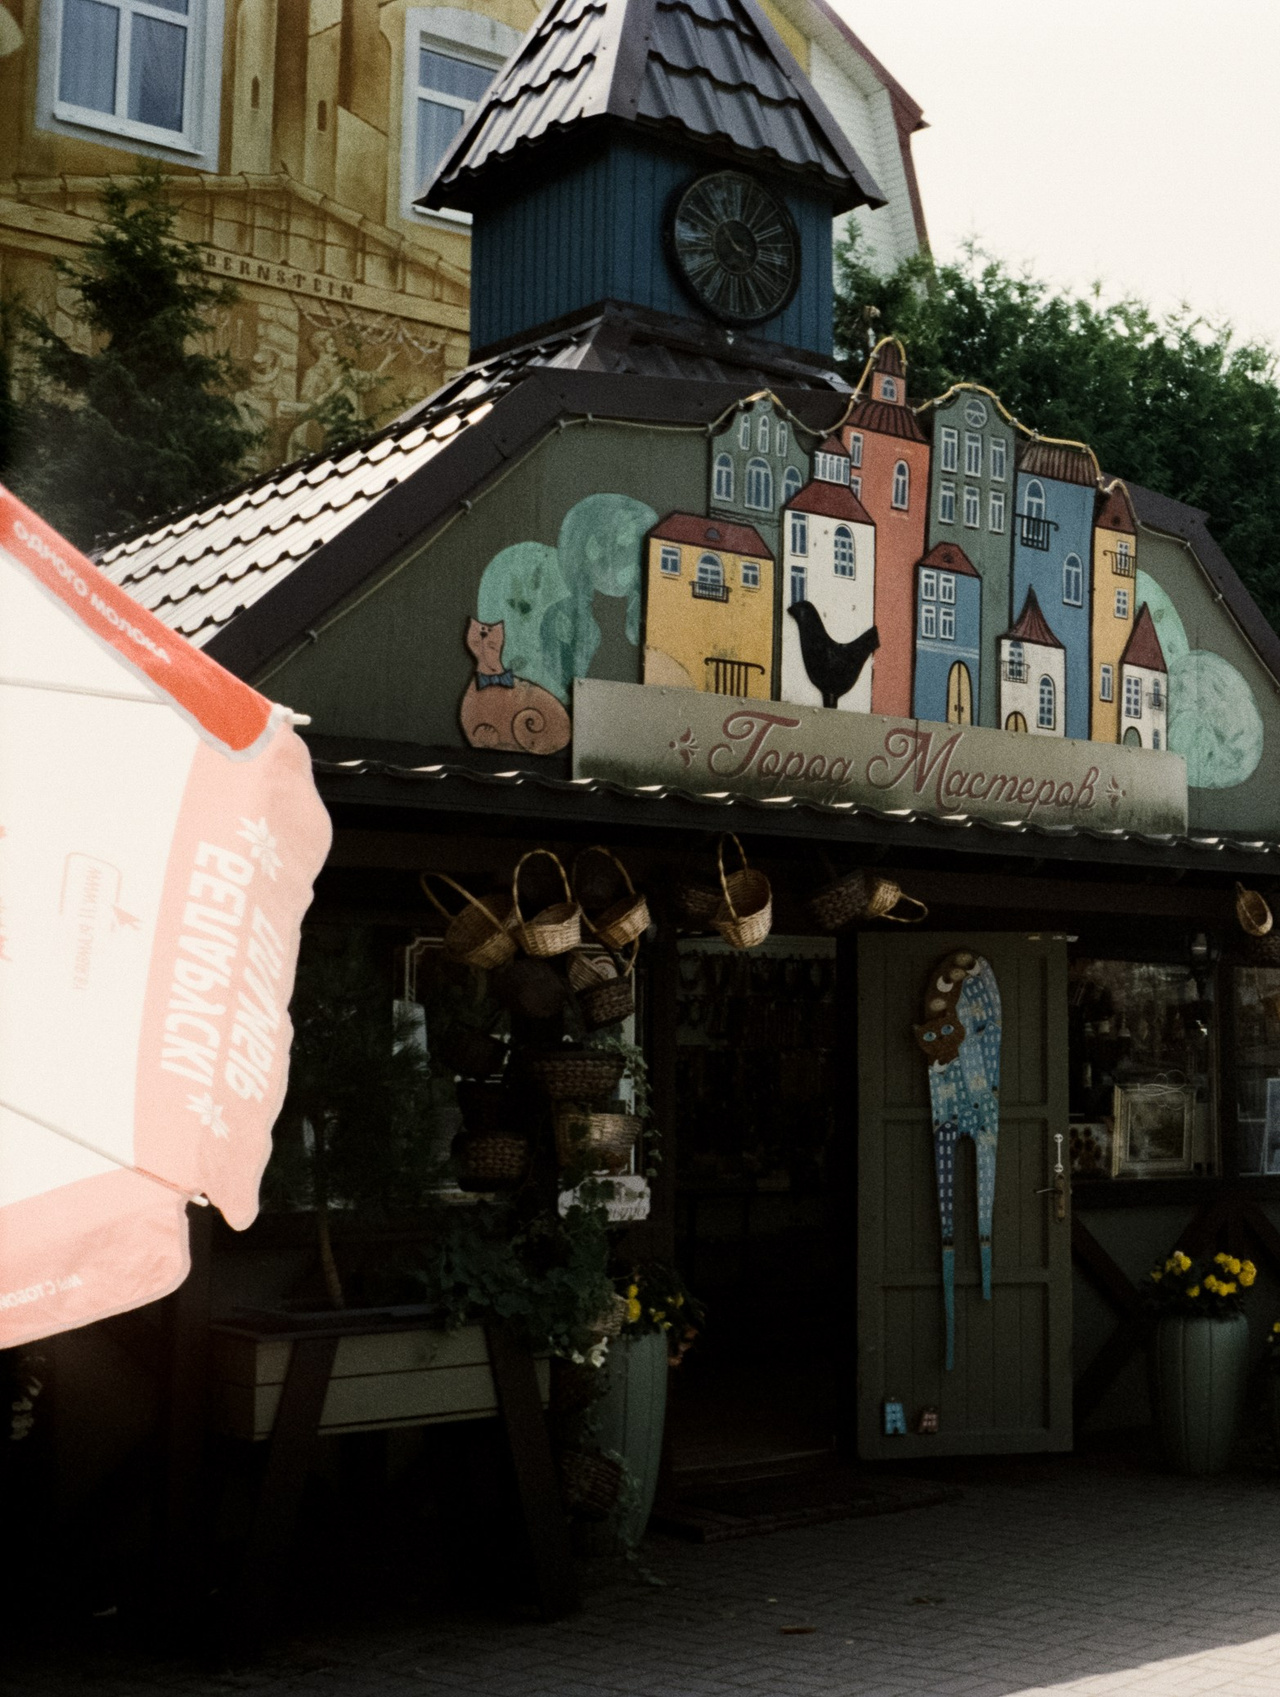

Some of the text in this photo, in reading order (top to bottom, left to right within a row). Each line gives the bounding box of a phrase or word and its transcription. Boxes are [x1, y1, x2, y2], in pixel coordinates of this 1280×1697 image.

[205, 252, 355, 301] BERNSTEIN
[707, 710, 1099, 816] Город Мастеров
